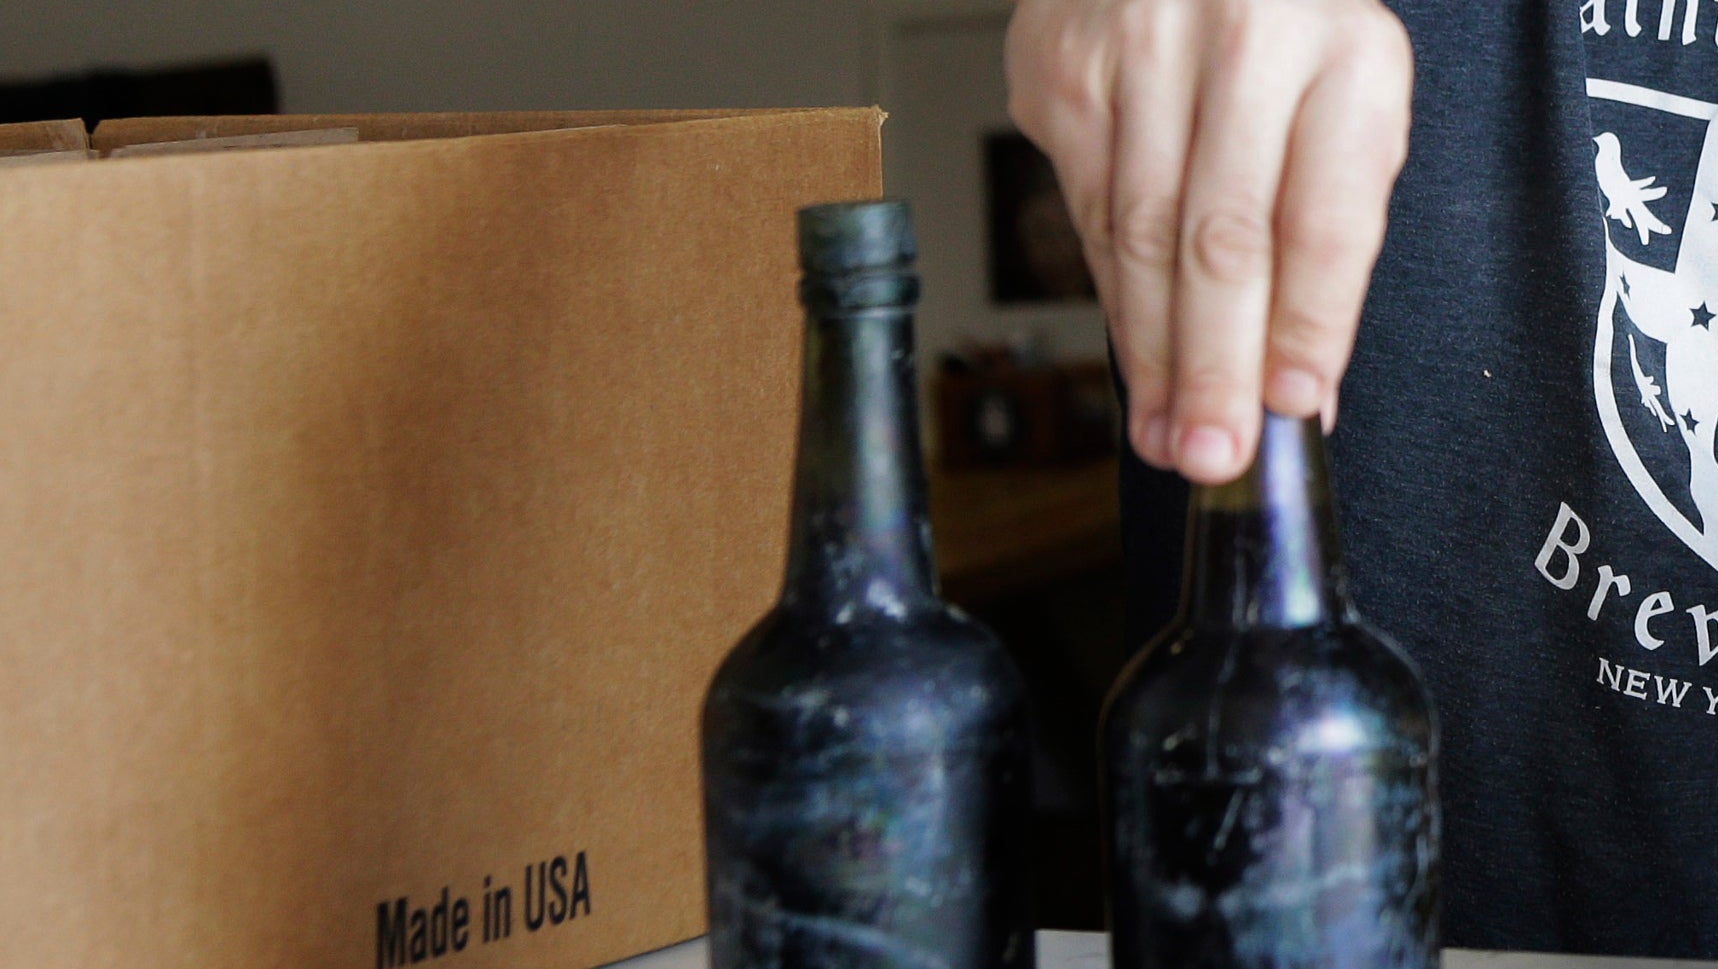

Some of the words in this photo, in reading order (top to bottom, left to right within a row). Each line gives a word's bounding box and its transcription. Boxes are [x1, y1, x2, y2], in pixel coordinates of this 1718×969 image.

[1596, 656, 1693, 709] NEW
[375, 885, 471, 969] Made
[482, 873, 512, 945] in
[524, 849, 592, 932] USA
